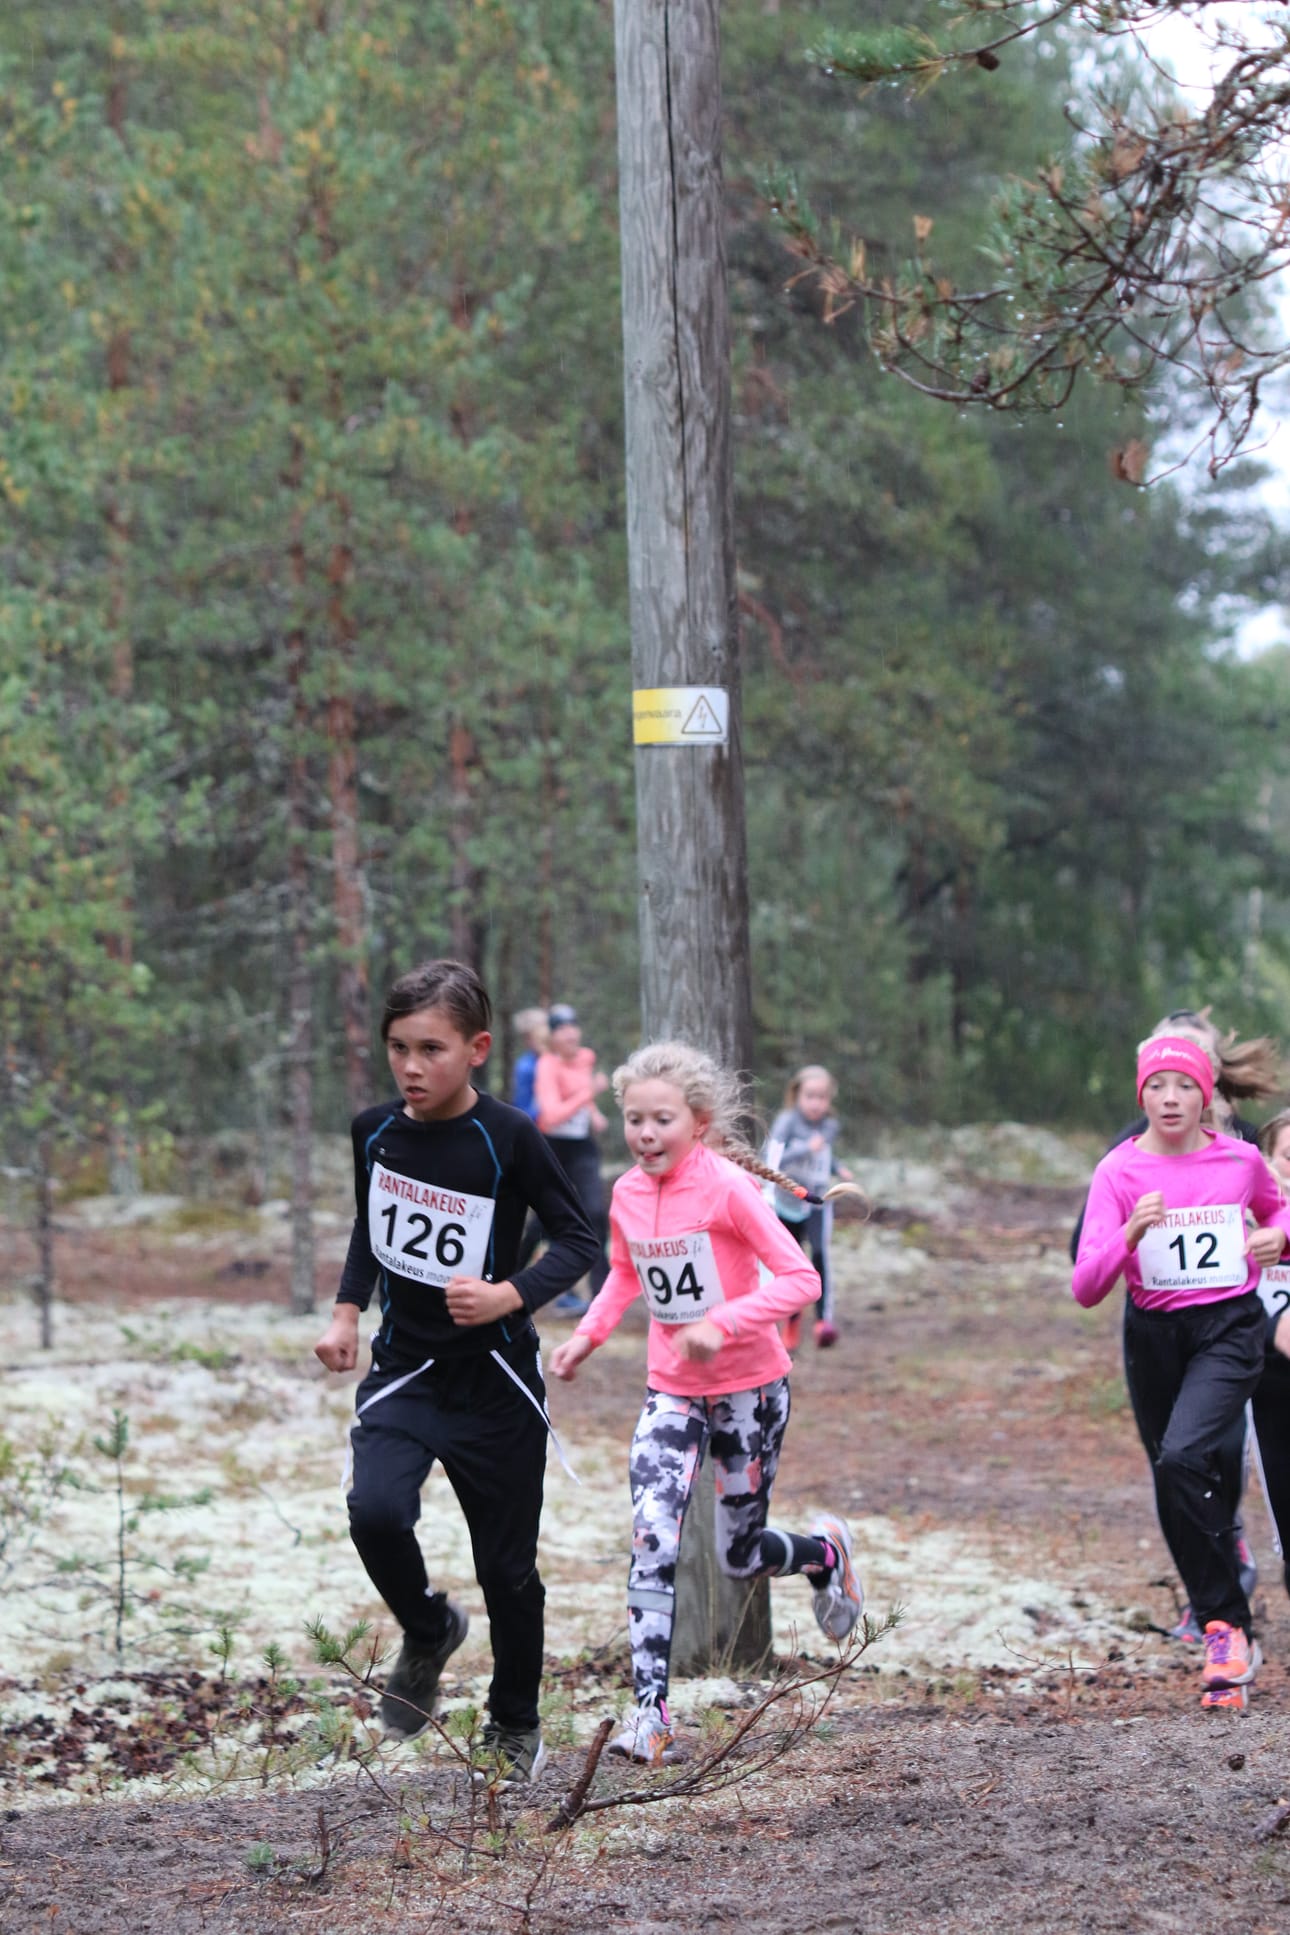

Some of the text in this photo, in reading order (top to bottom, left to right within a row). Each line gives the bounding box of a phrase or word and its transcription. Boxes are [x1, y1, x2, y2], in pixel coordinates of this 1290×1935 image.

[378, 1171, 467, 1217] RANTALAKEUS
[381, 1203, 467, 1267] 126
[1169, 1231, 1220, 1271] 12
